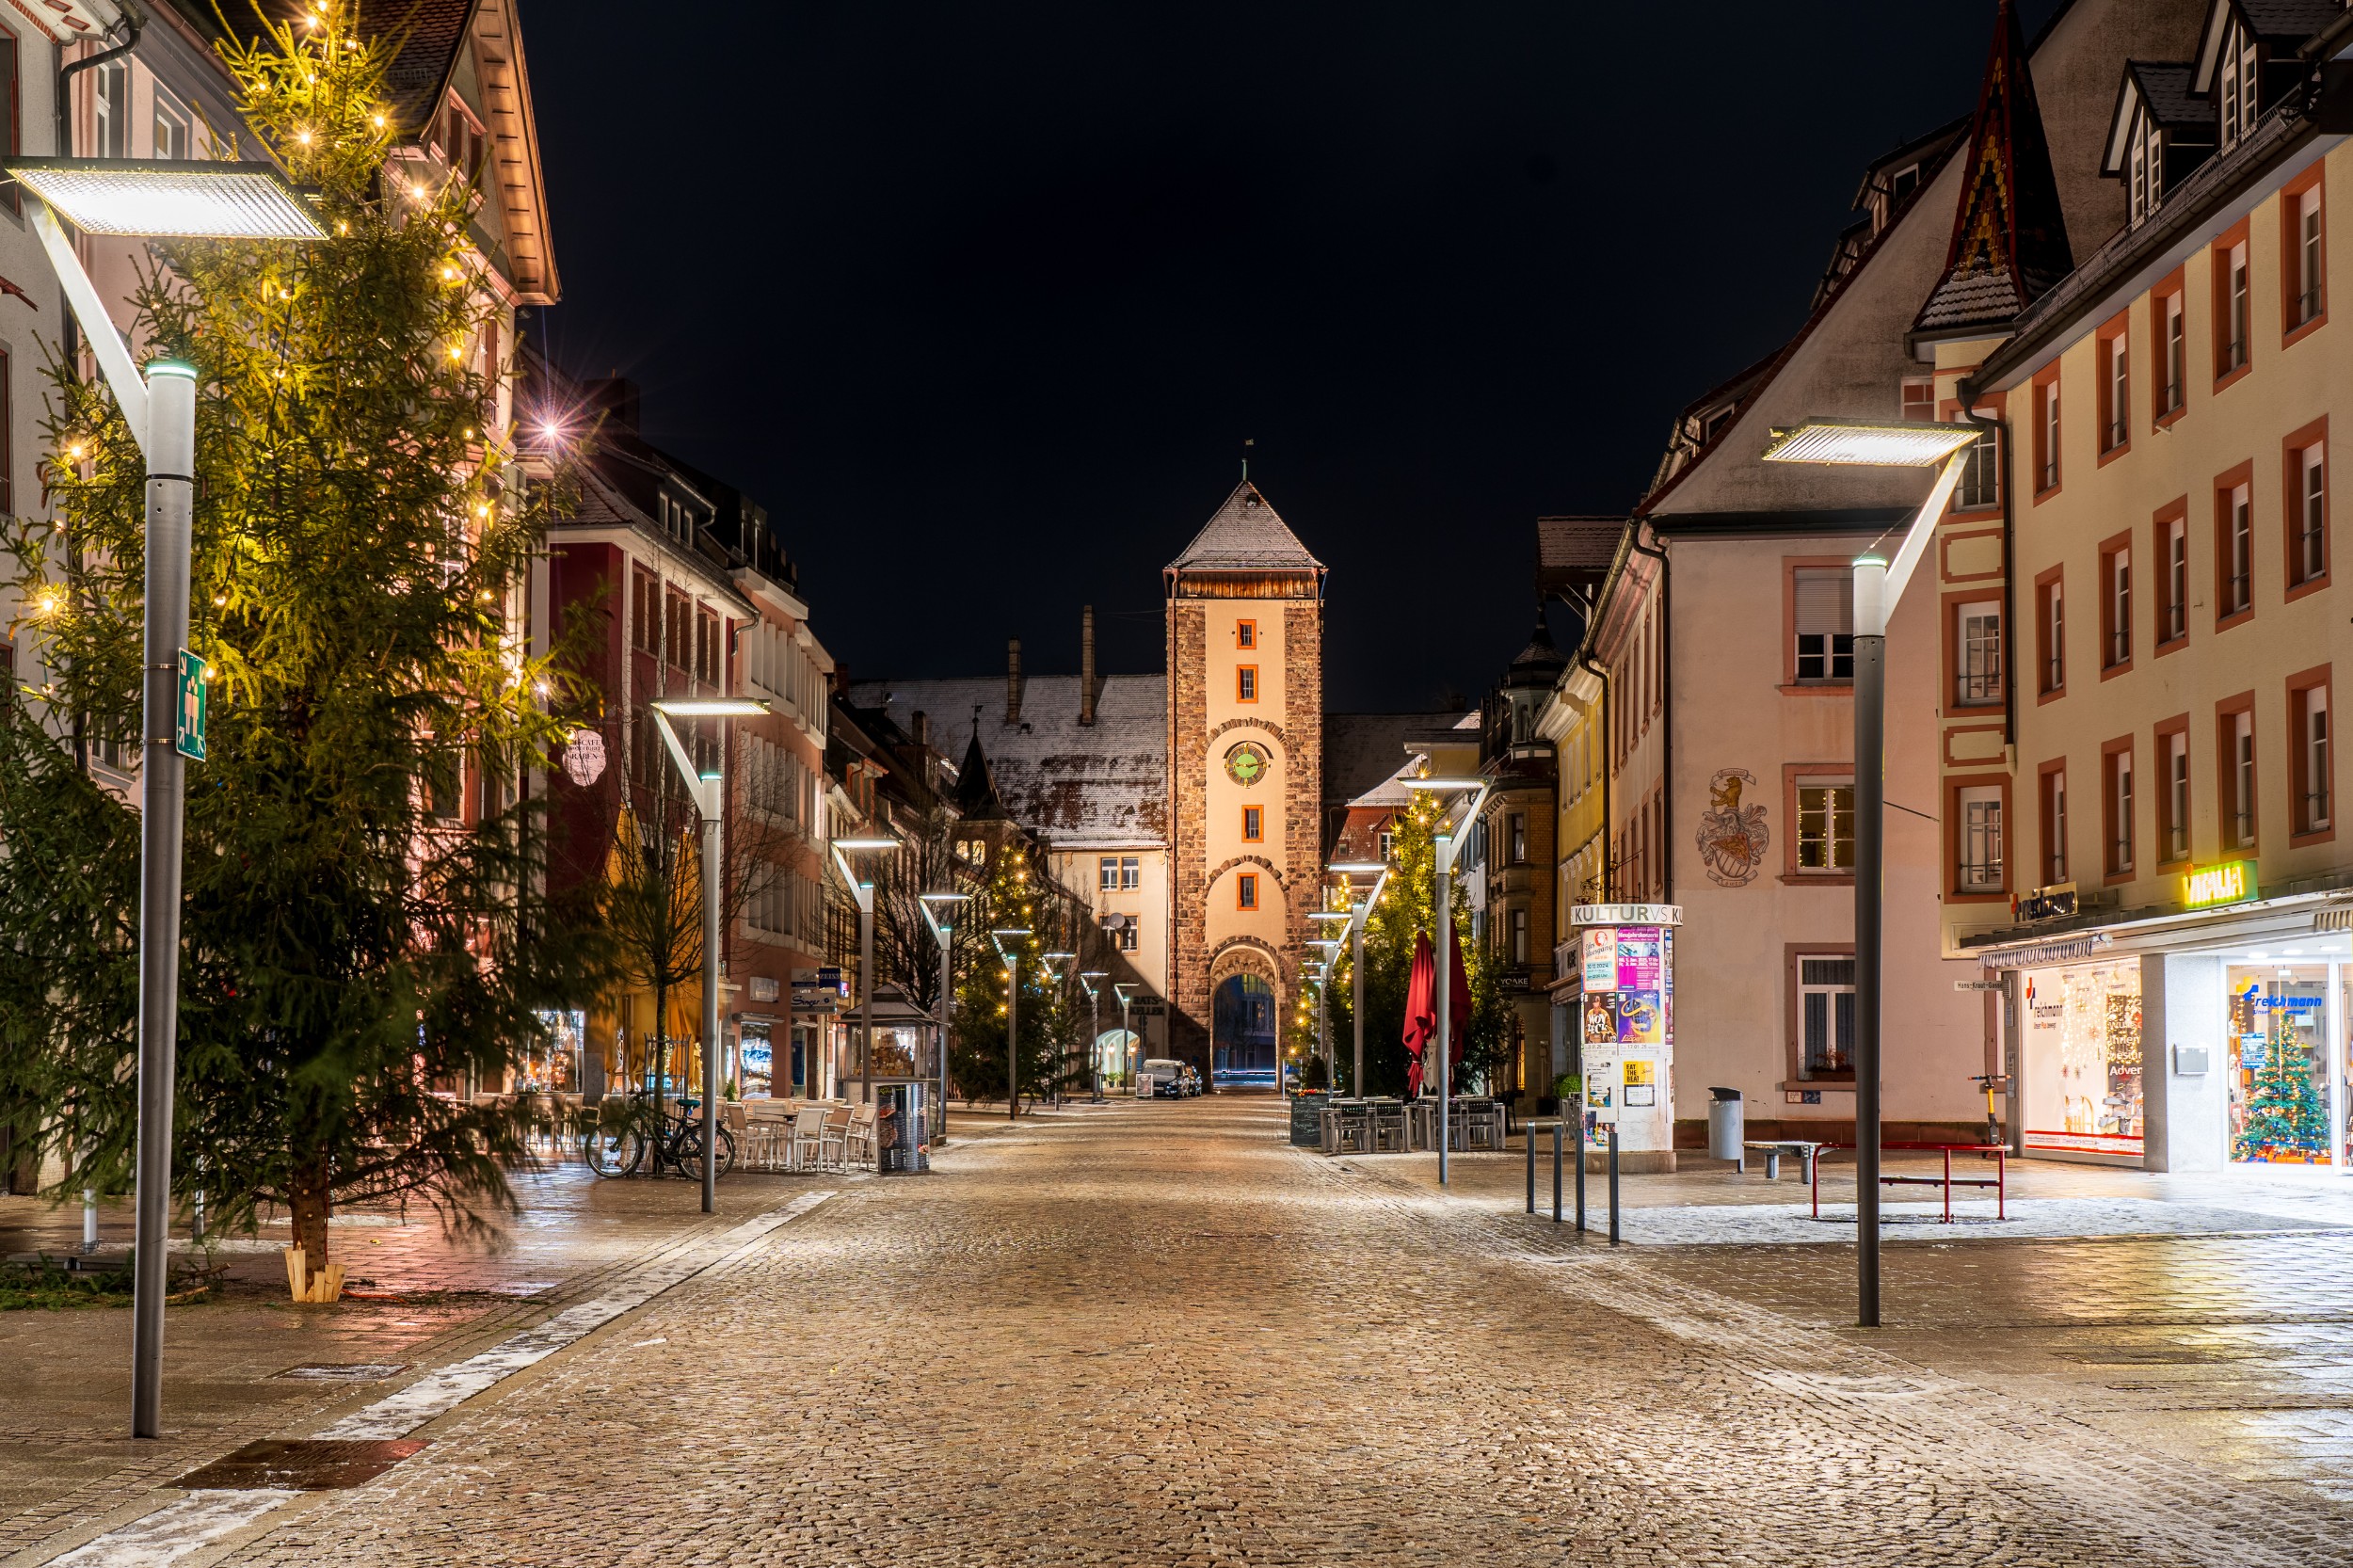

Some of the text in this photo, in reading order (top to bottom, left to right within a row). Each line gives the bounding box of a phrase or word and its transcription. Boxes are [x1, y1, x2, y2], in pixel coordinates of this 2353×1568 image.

[2022, 888, 2075, 921] reichmann
[792, 996, 820, 1007] Singer
[2254, 994, 2322, 1007] reichmann
[2034, 1001, 2062, 1018] reichmann
